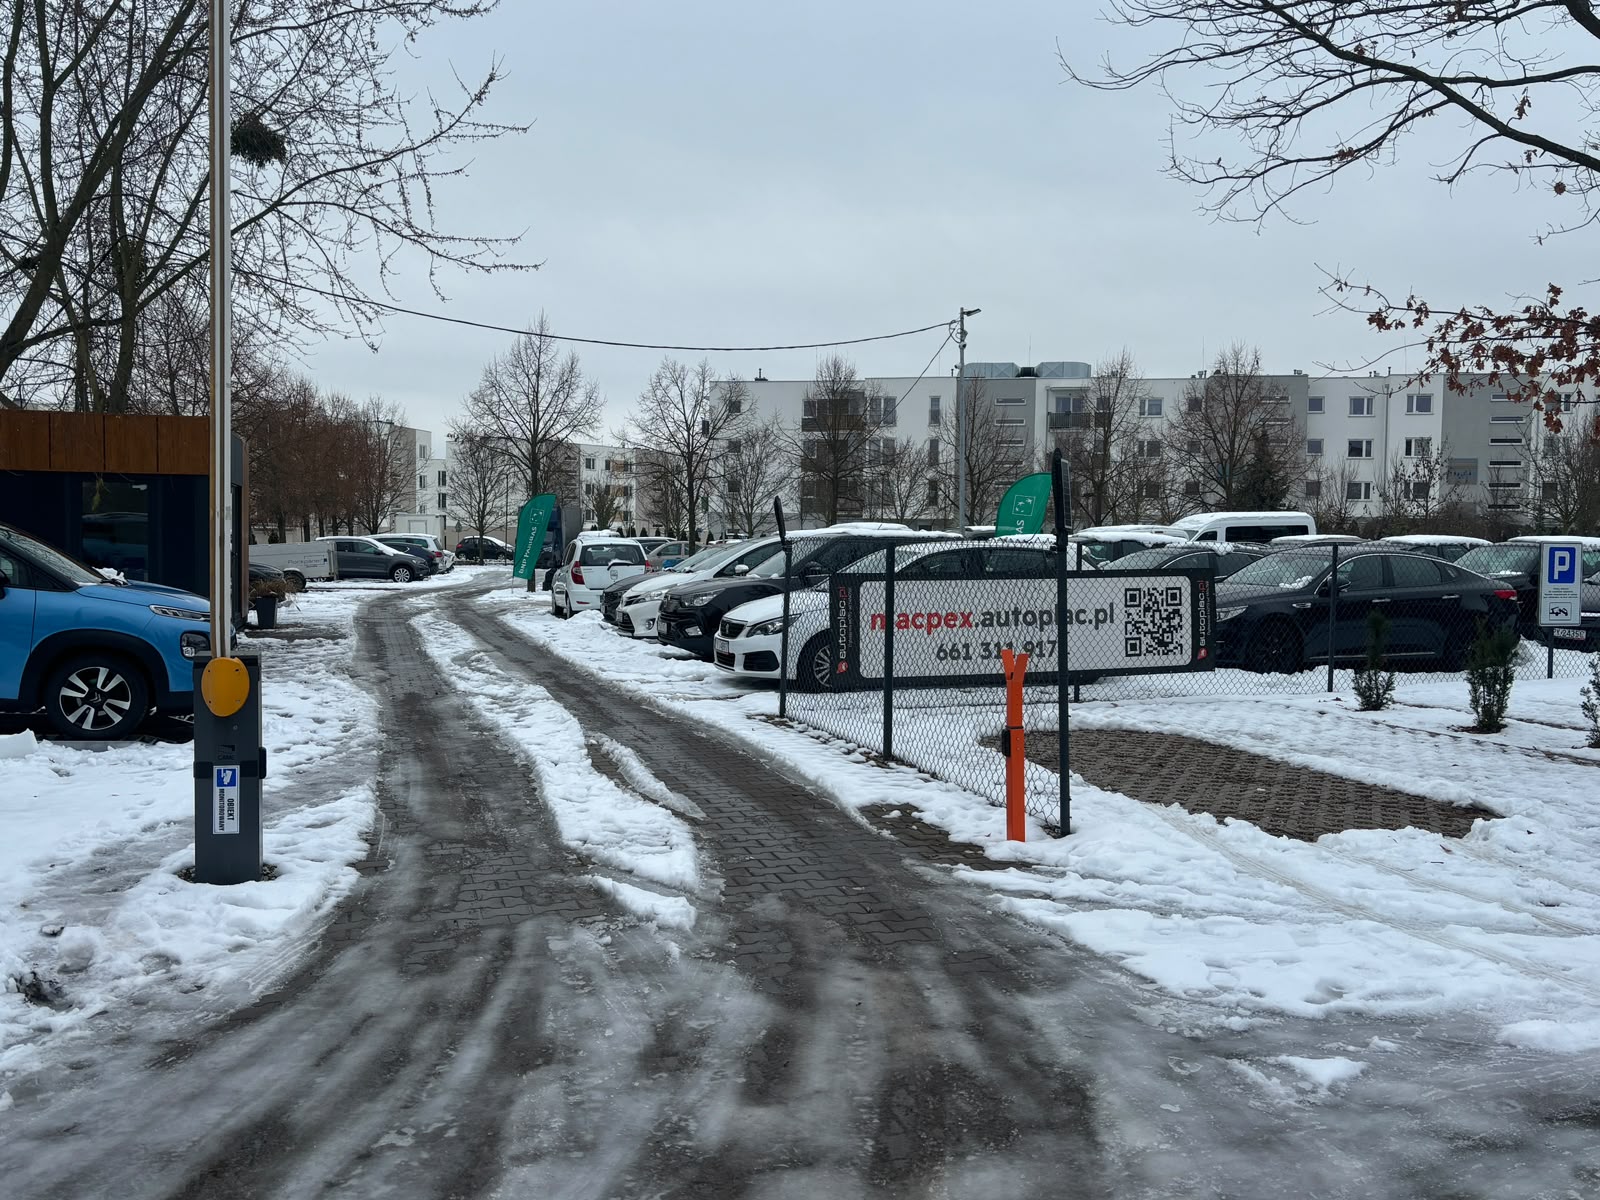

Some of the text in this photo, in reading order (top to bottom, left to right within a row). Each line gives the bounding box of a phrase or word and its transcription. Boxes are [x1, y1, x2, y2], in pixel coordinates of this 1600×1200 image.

[1553, 551, 1570, 580] P
[936, 642, 973, 660] 661
[1022, 640, 1058, 658] 917
[227, 798, 235, 821] OBIEKT
